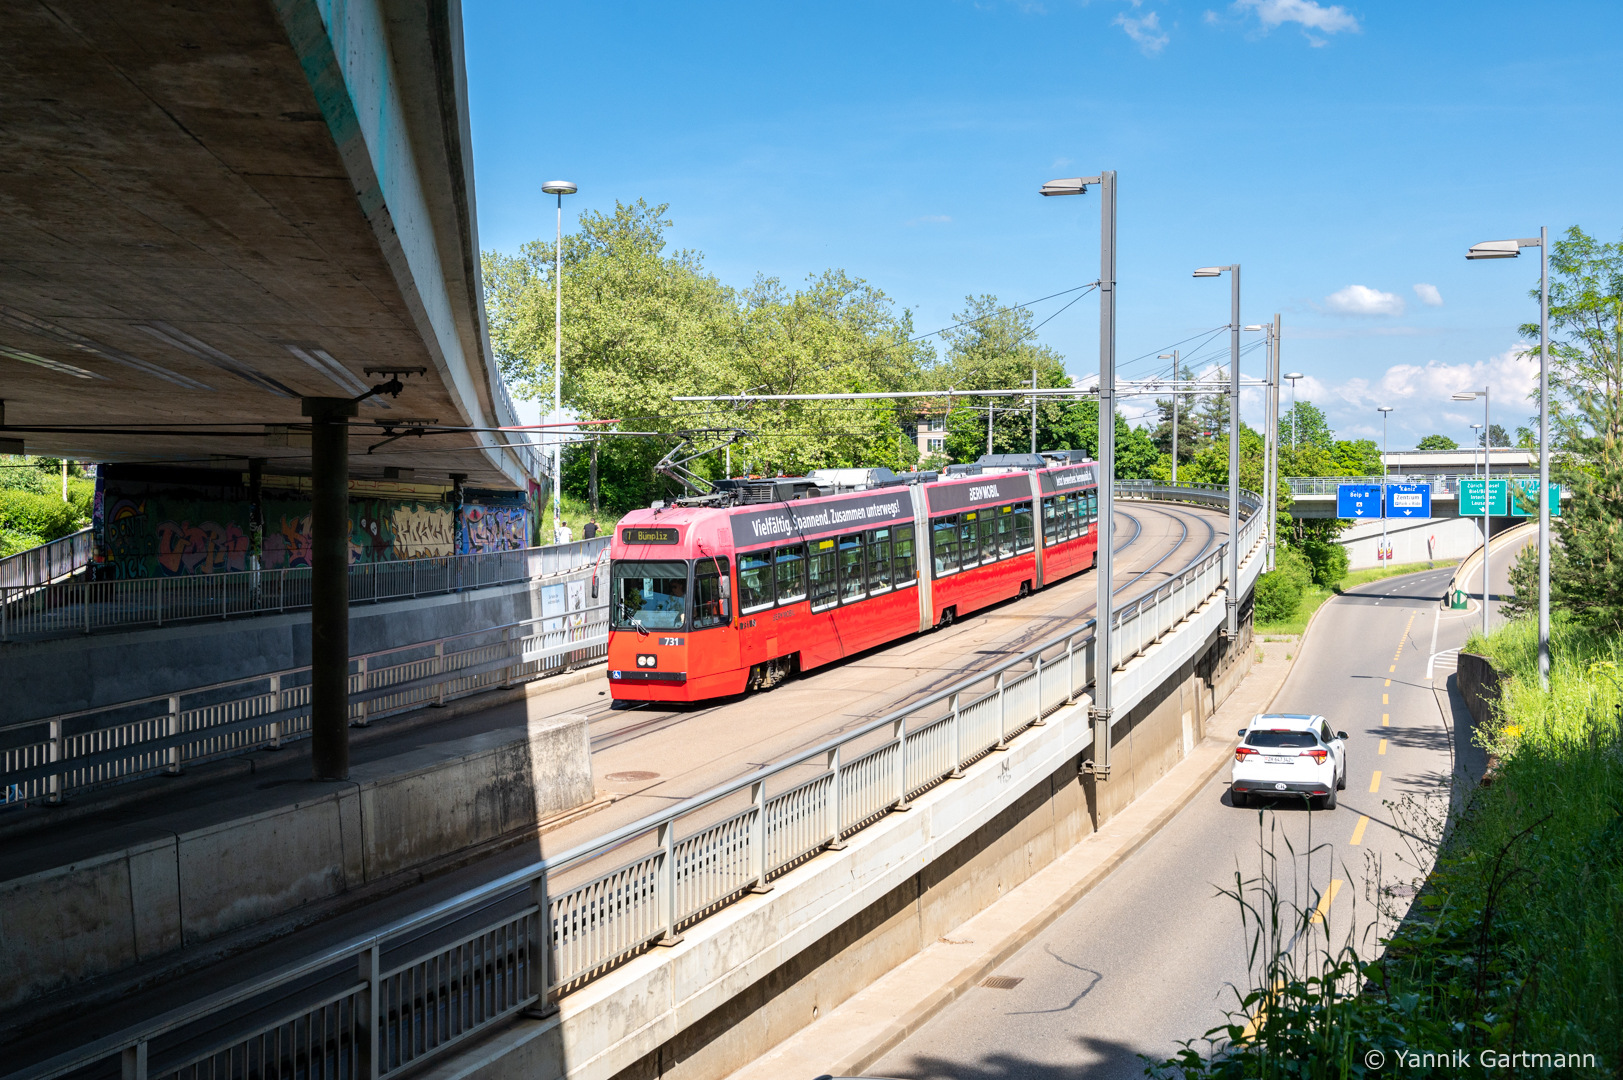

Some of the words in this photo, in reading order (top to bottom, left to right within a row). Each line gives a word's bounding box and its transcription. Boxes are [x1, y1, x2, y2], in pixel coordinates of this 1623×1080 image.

[752, 515, 793, 537] Vielfältig.
[793, 509, 831, 533] Spannend.
[830, 507, 867, 524] Zusammen
[866, 499, 901, 518] unterwegs!
[638, 531, 668, 541] Bümpliz
[664, 637, 679, 646] 731
